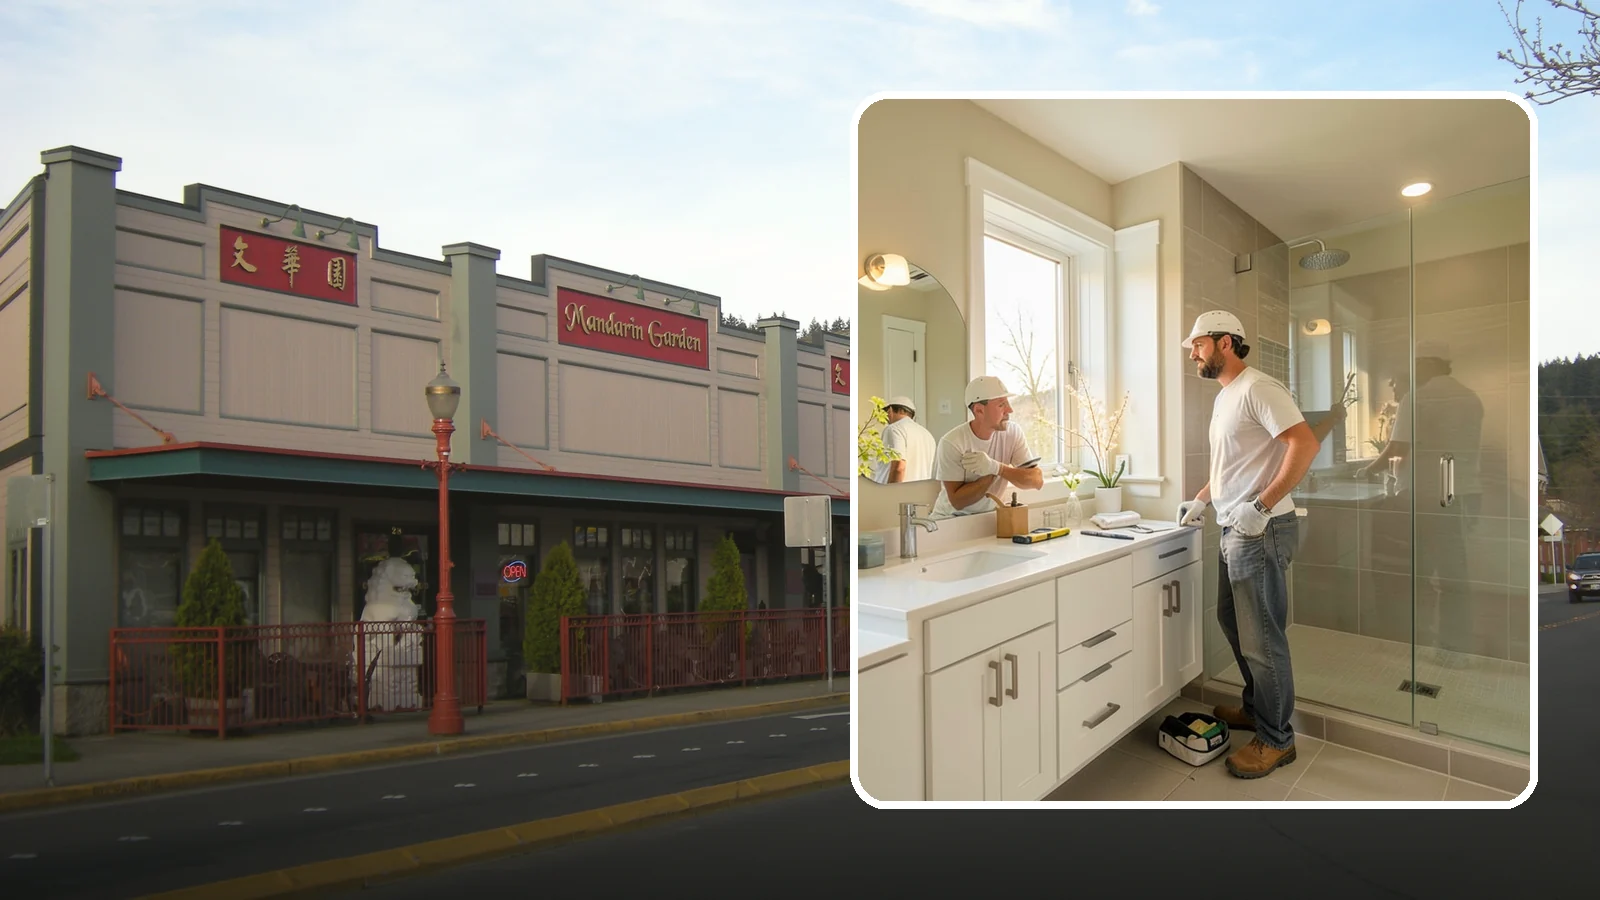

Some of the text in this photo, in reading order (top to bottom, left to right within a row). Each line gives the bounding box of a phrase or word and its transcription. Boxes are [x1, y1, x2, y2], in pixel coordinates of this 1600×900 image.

[230, 235, 347, 291] 文華園
[564, 302, 702, 352] Mandarin Garden
[503, 565, 527, 578] OPEN
